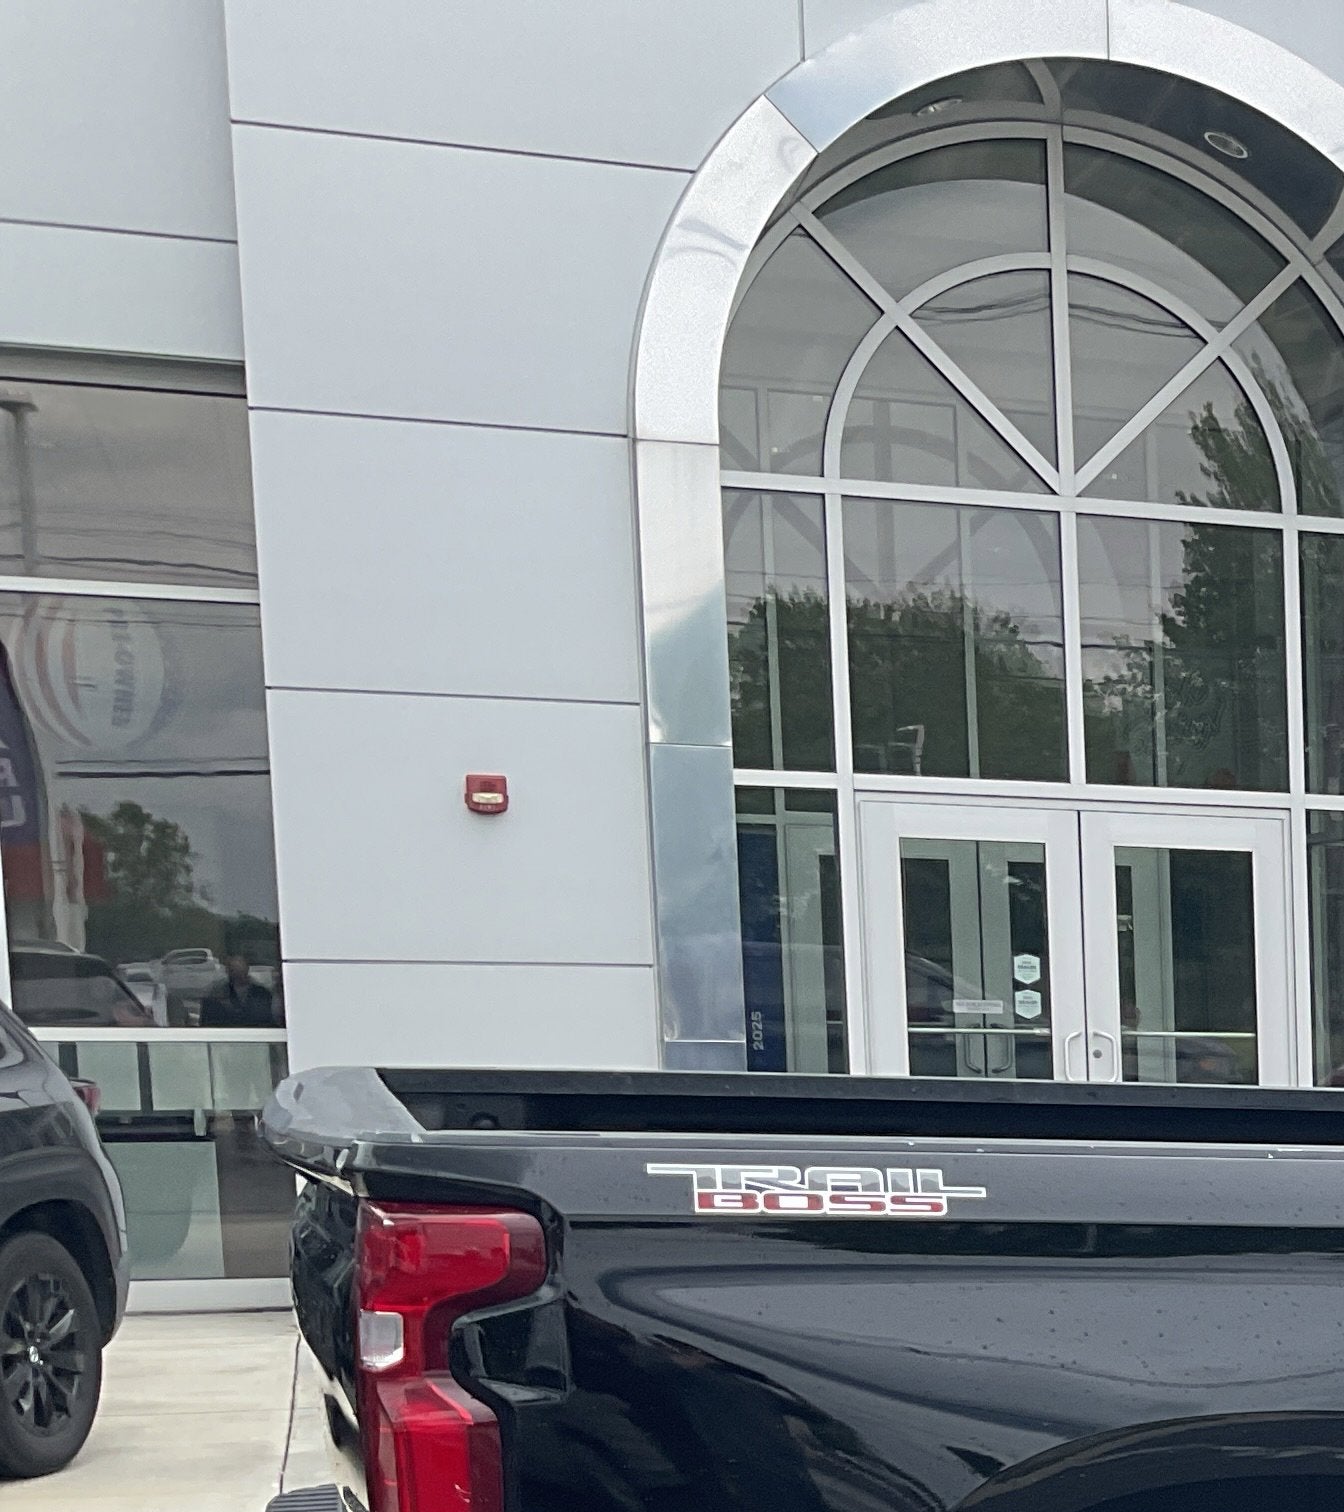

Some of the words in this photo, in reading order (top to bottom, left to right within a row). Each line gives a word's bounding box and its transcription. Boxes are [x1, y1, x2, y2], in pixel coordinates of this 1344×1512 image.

[751, 1011, 764, 1051] 2025
[645, 1162, 987, 1199] TRAIL
[694, 1189, 949, 1217] BOSS
